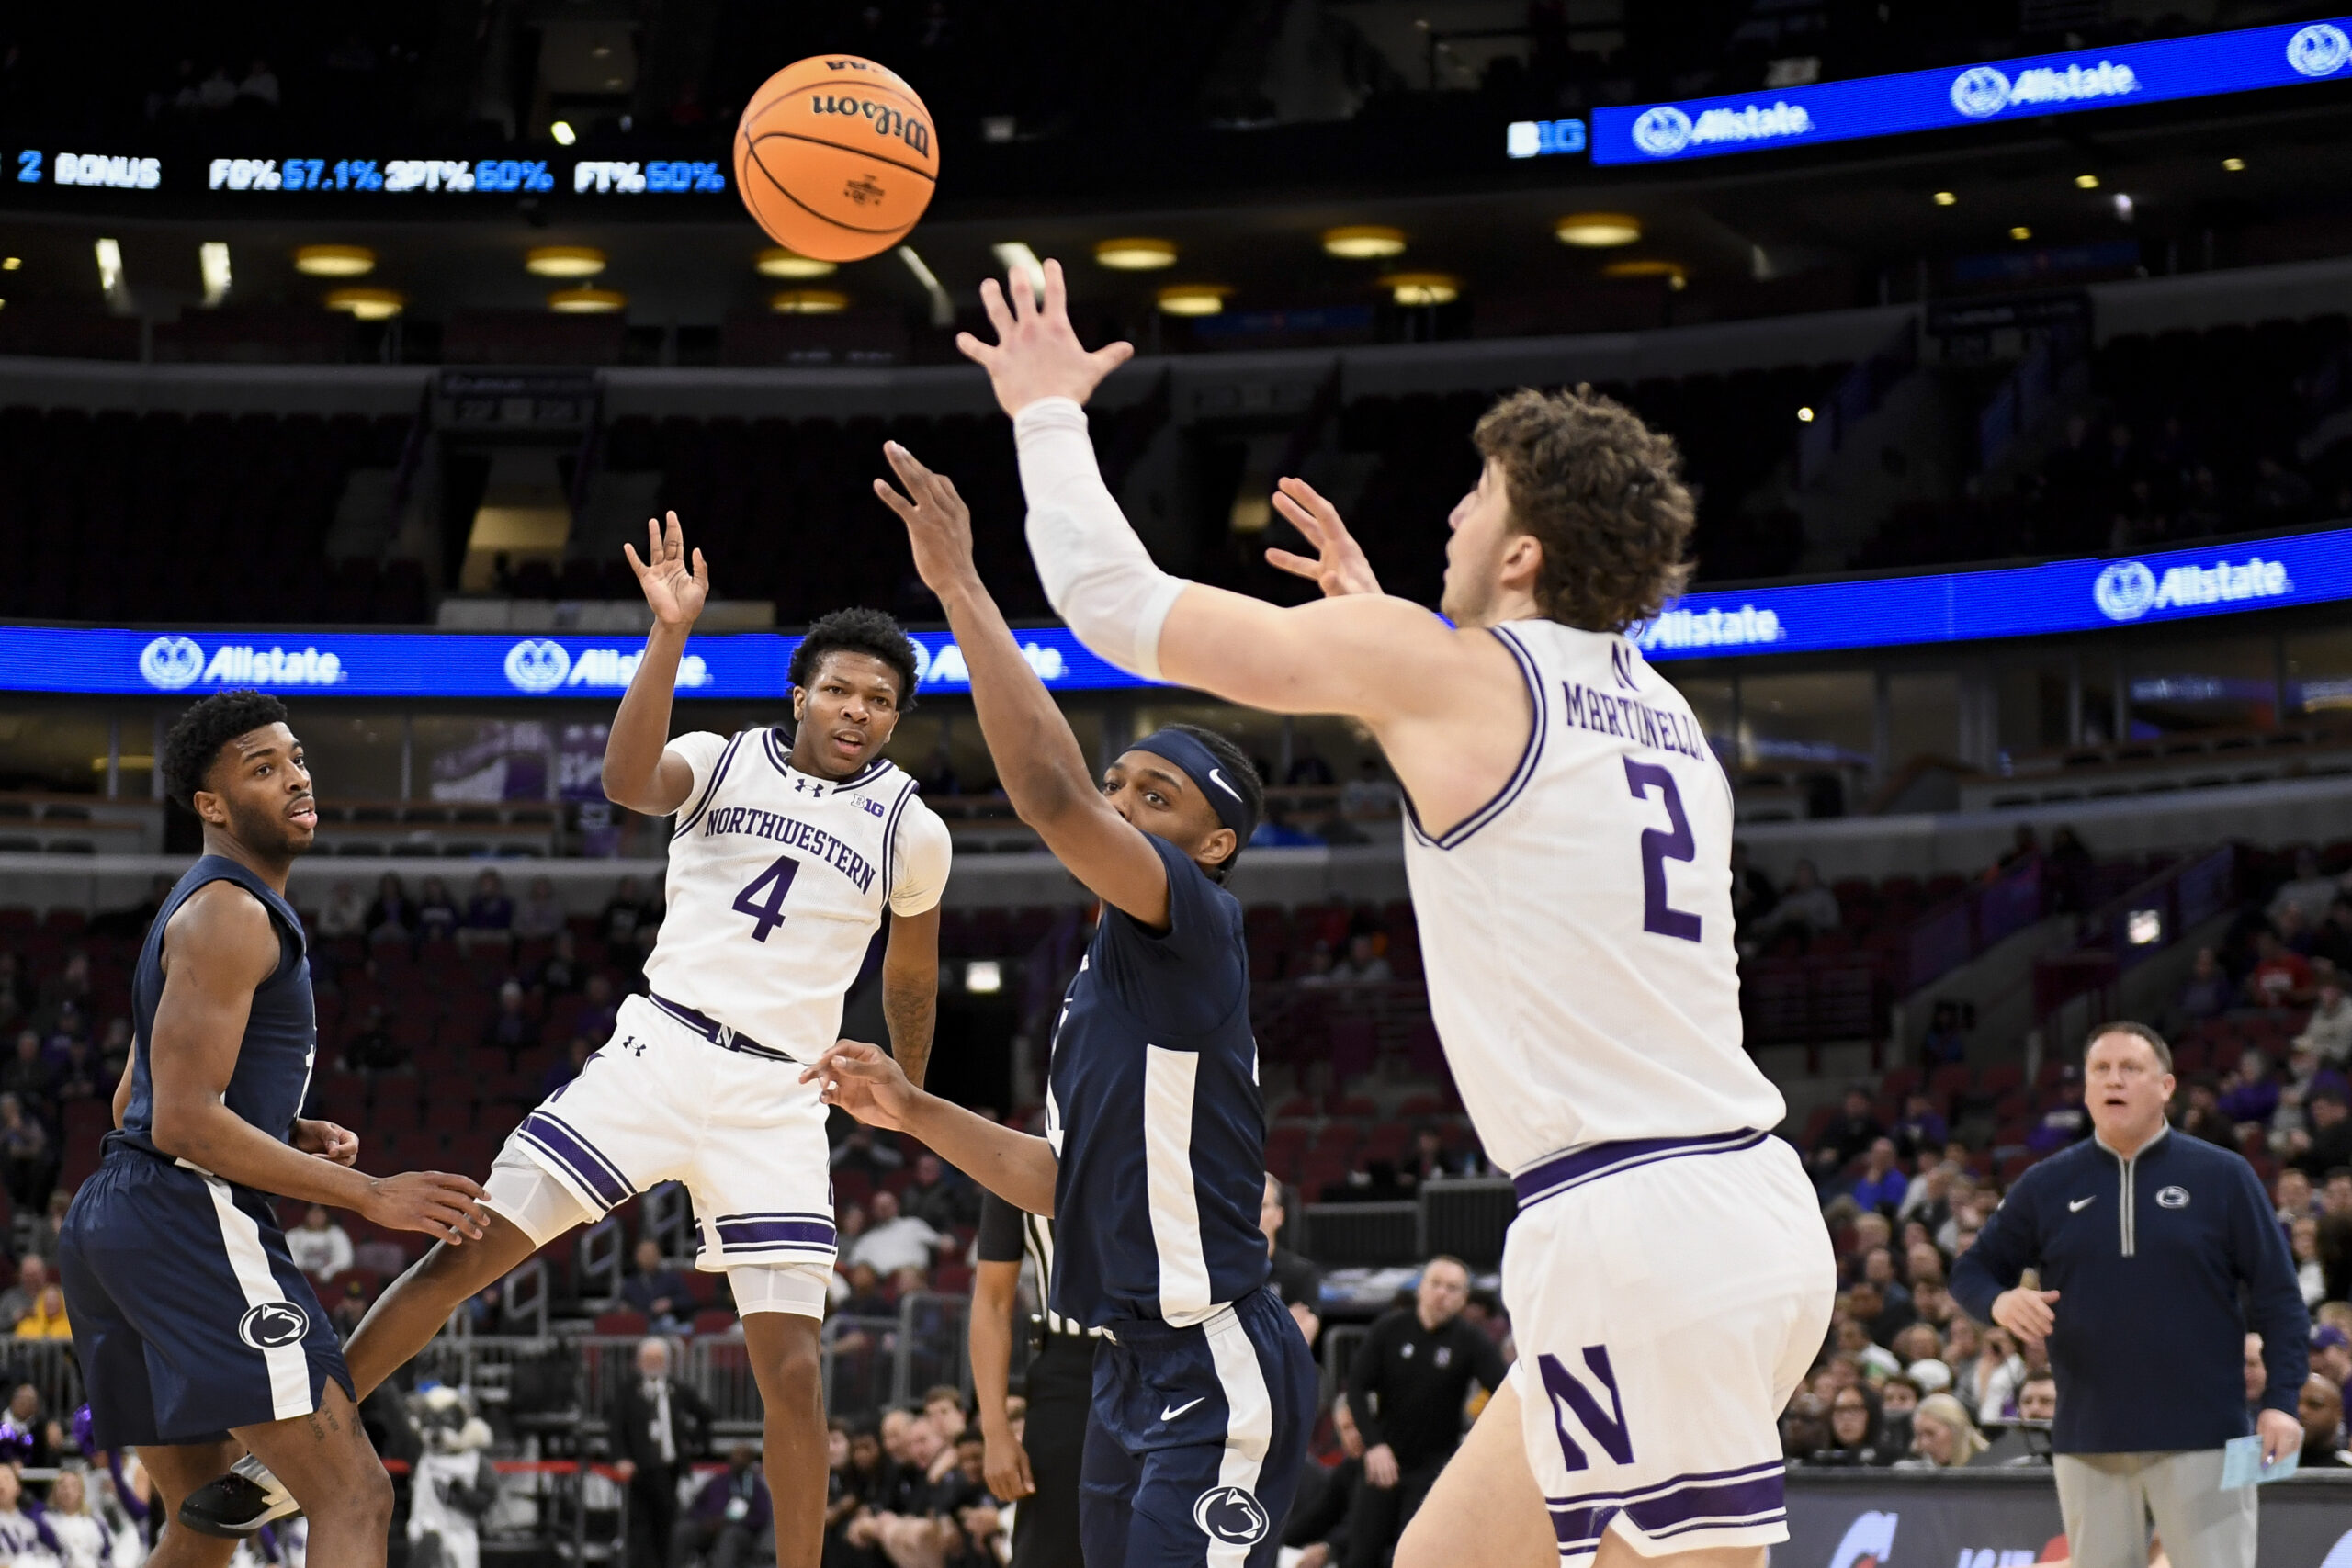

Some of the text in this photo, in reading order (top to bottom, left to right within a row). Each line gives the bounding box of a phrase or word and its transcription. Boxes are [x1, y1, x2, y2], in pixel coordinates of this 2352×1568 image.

[2010, 60, 2135, 106] Allstate
[812, 95, 930, 159] Wilson
[1690, 101, 1810, 143] Allstate
[17, 149, 42, 183] 2
[54, 152, 161, 189] BONUS
[2154, 558, 2288, 609] Allstate
[1644, 604, 1780, 650] Allstate
[201, 646, 341, 684] Allstate
[705, 807, 876, 896] NORTHWESTERN
[1622, 752, 1702, 942] 2
[731, 855, 800, 943] 4
[1537, 1344, 1635, 1472] N
